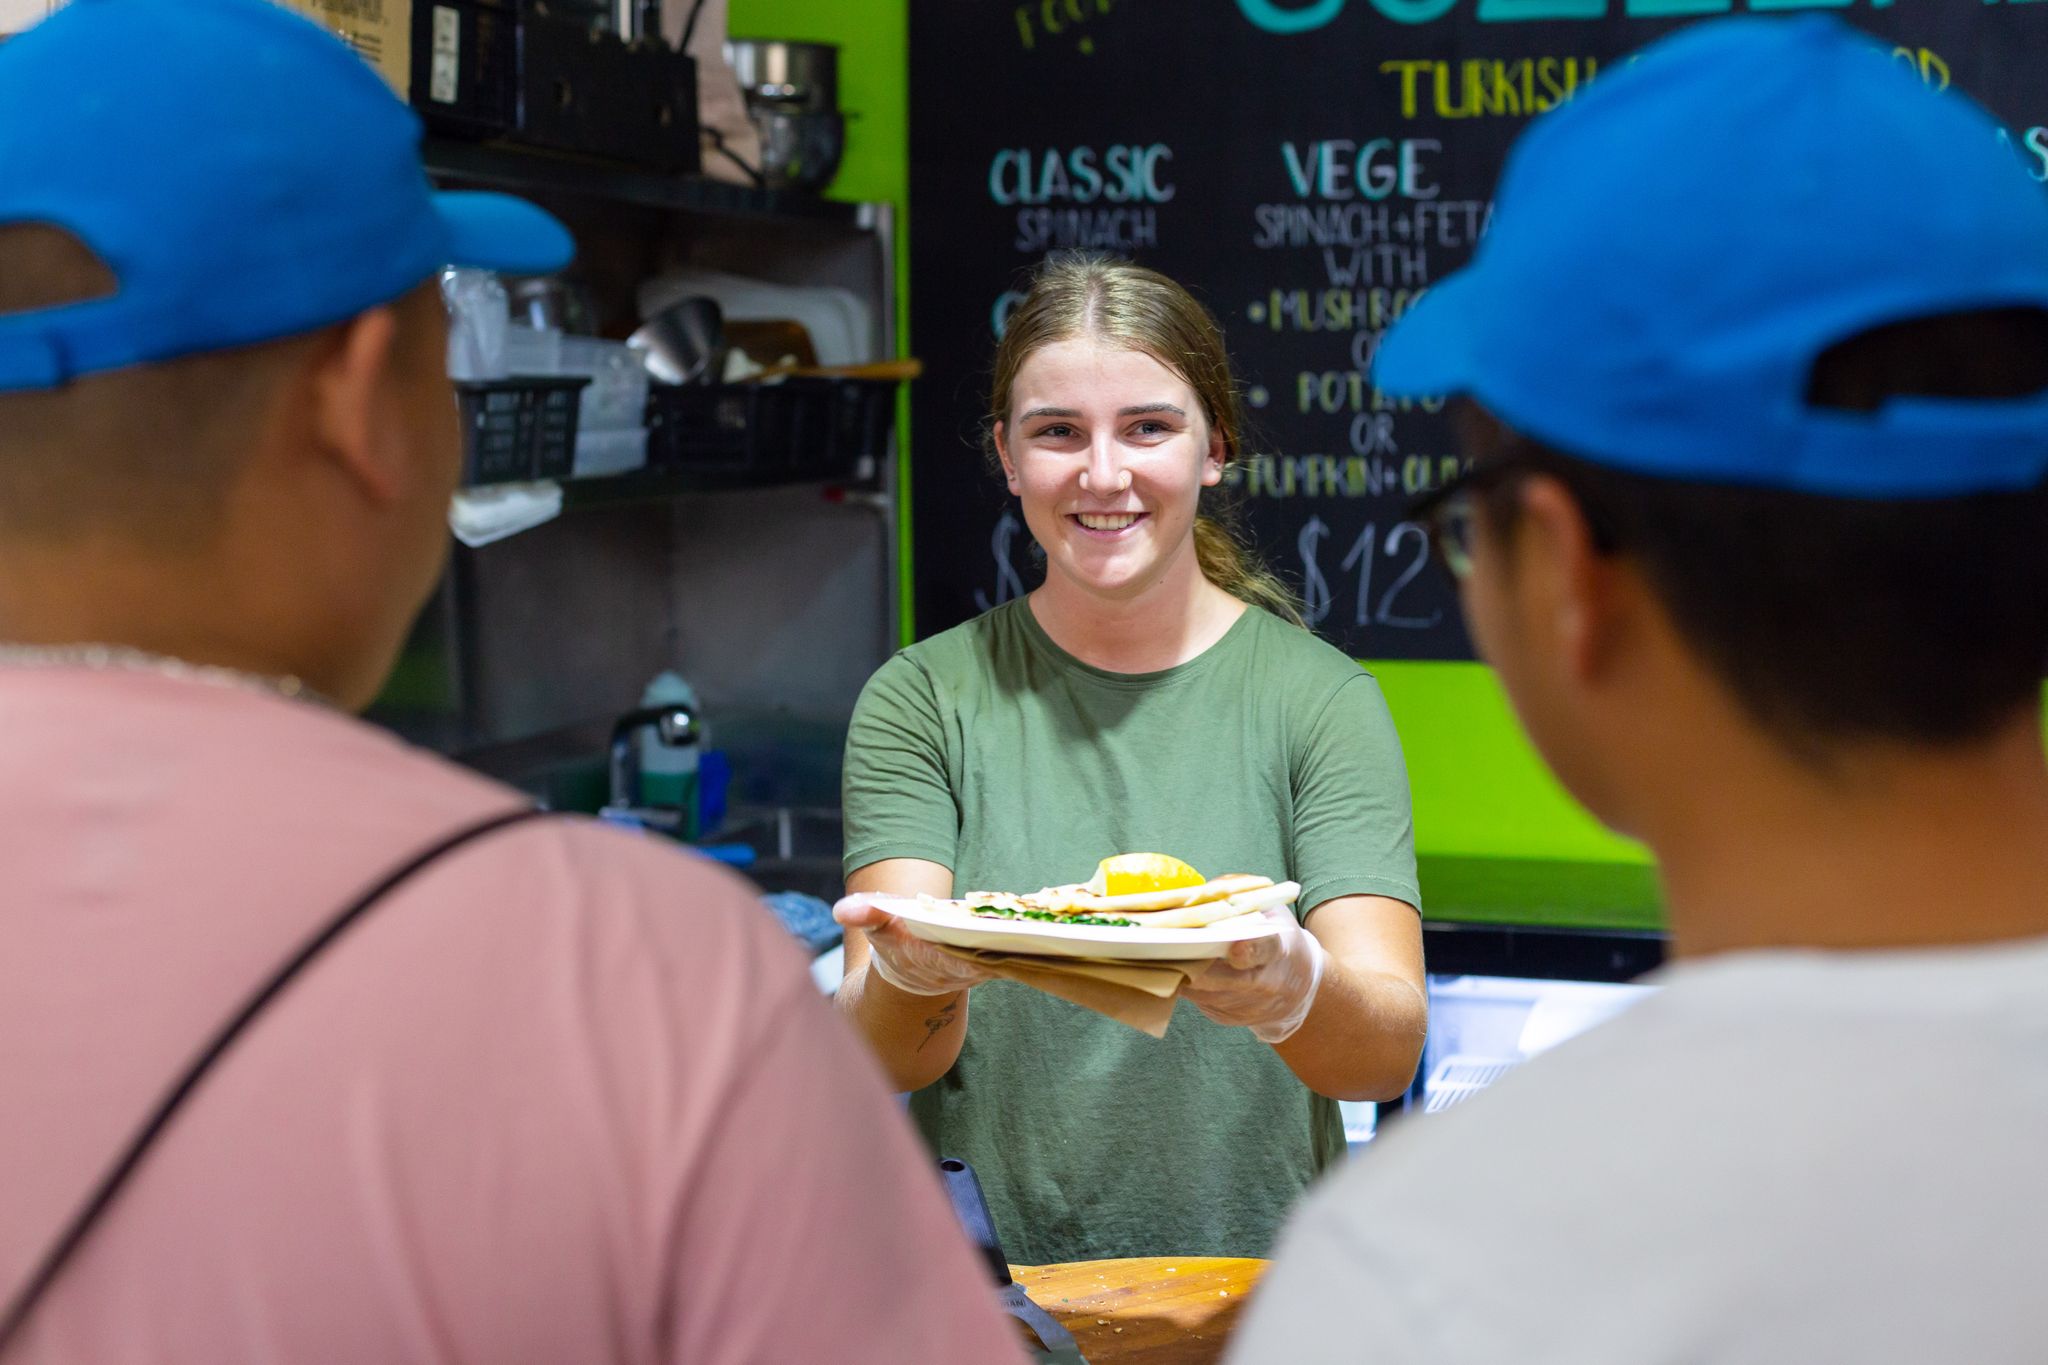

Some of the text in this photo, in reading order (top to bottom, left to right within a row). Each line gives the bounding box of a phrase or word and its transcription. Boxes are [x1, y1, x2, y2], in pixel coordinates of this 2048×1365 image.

[988, 143, 1175, 205] CLASSIC
[1280, 138, 1442, 201] VEGE
[1015, 207, 1158, 252] SPINACH
[1323, 245, 1427, 286] WITH
[1269, 288, 1426, 332] MUSHR
[1351, 330, 1384, 374] O
[1350, 412, 1397, 456] OR
[1298, 514, 1443, 629] $12
